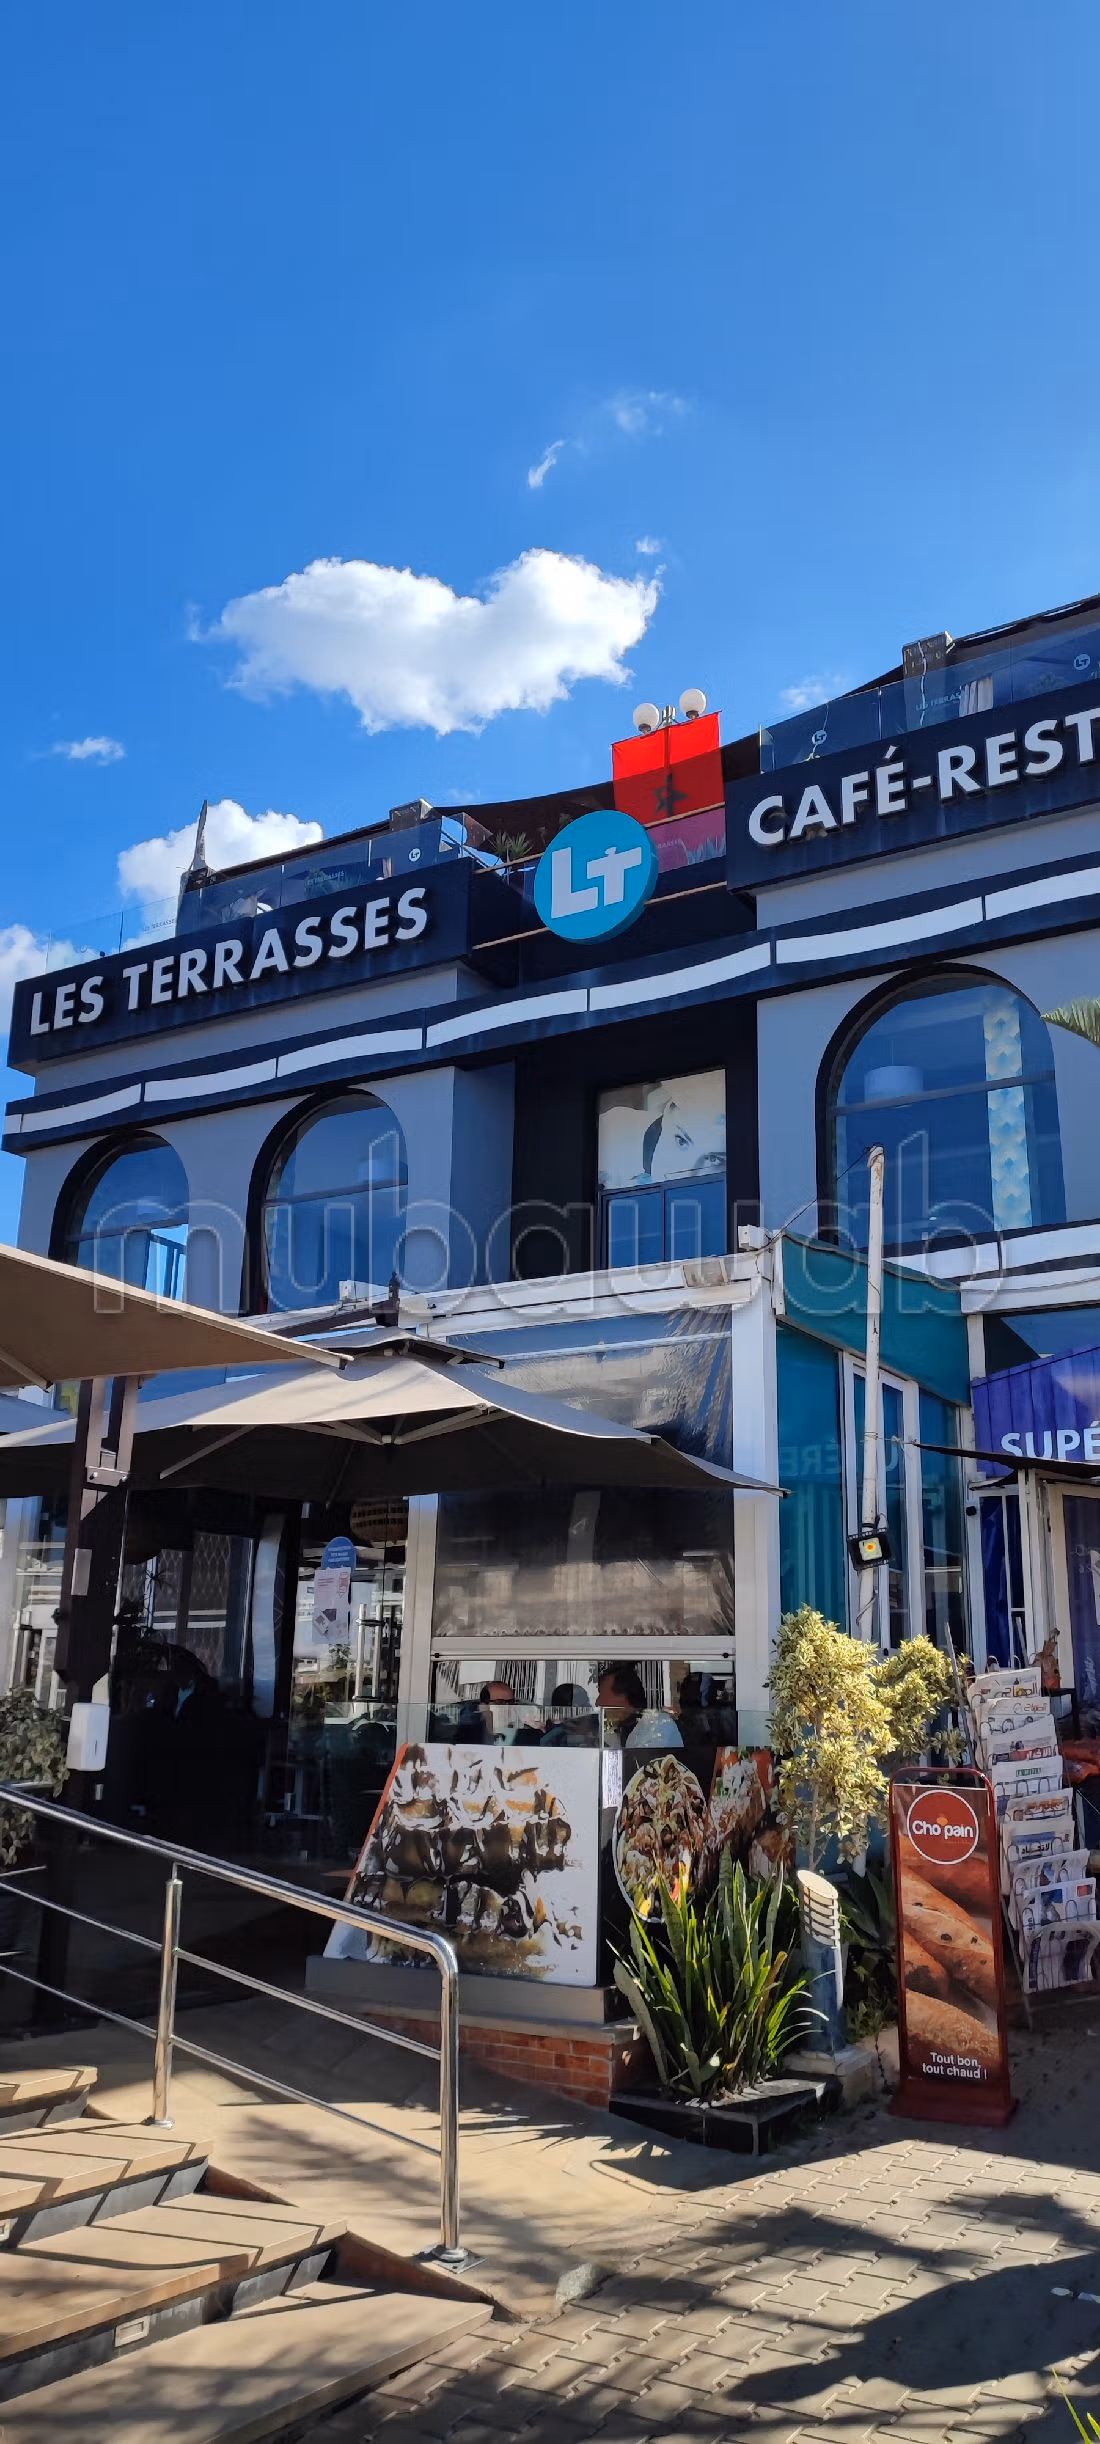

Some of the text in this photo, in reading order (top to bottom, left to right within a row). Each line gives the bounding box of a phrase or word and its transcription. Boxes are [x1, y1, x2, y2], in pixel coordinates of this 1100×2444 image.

[747, 707, 1100, 847] CAFÉ-REST
[550, 846, 643, 919] LT
[30, 886, 429, 1036] LES TERRASSES
[912, 1820, 974, 1840] Cho pain
[922, 2062, 944, 2075] tout
[946, 2066, 981, 2079] chaud
[930, 2052, 982, 2069] Tout bon,
